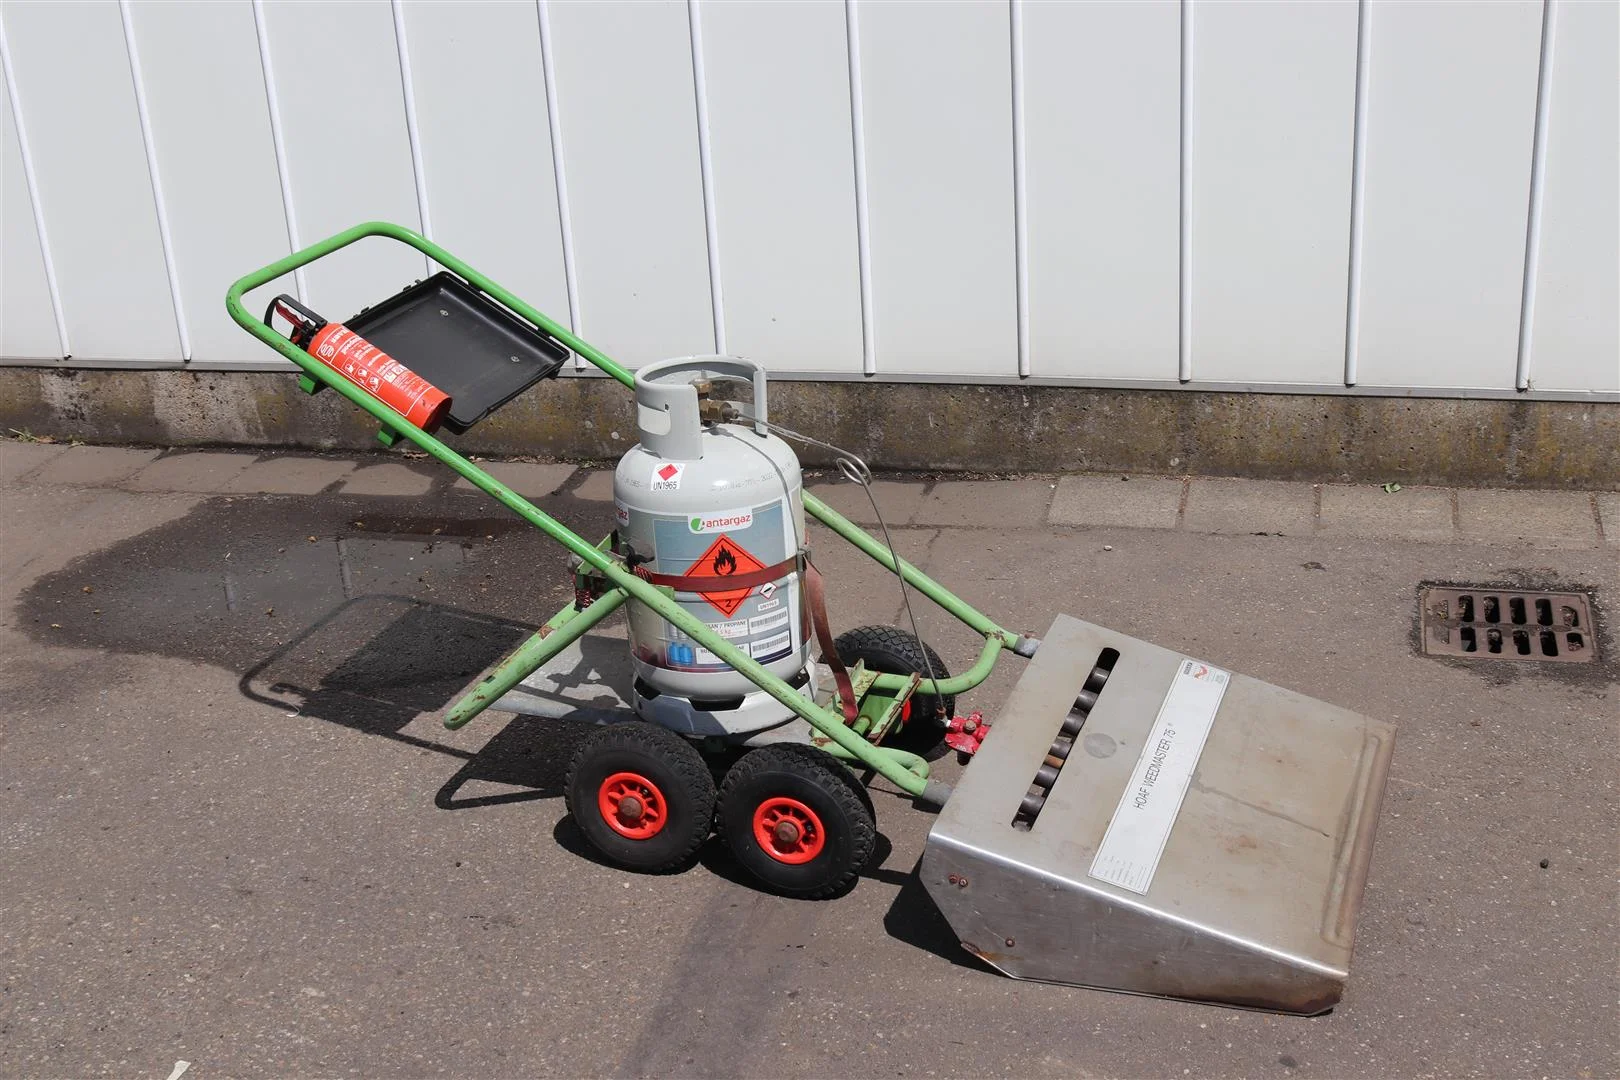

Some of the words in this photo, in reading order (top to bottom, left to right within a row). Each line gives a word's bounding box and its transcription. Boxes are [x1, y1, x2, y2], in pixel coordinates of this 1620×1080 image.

[653, 481, 677, 490] UN1965
[706, 513, 751, 528] antargaz
[725, 600, 732, 608] 2
[1133, 786, 1150, 810] HOAF
[1143, 738, 1171, 787] WEEDMASTER
[1163, 728, 1176, 739] 75
